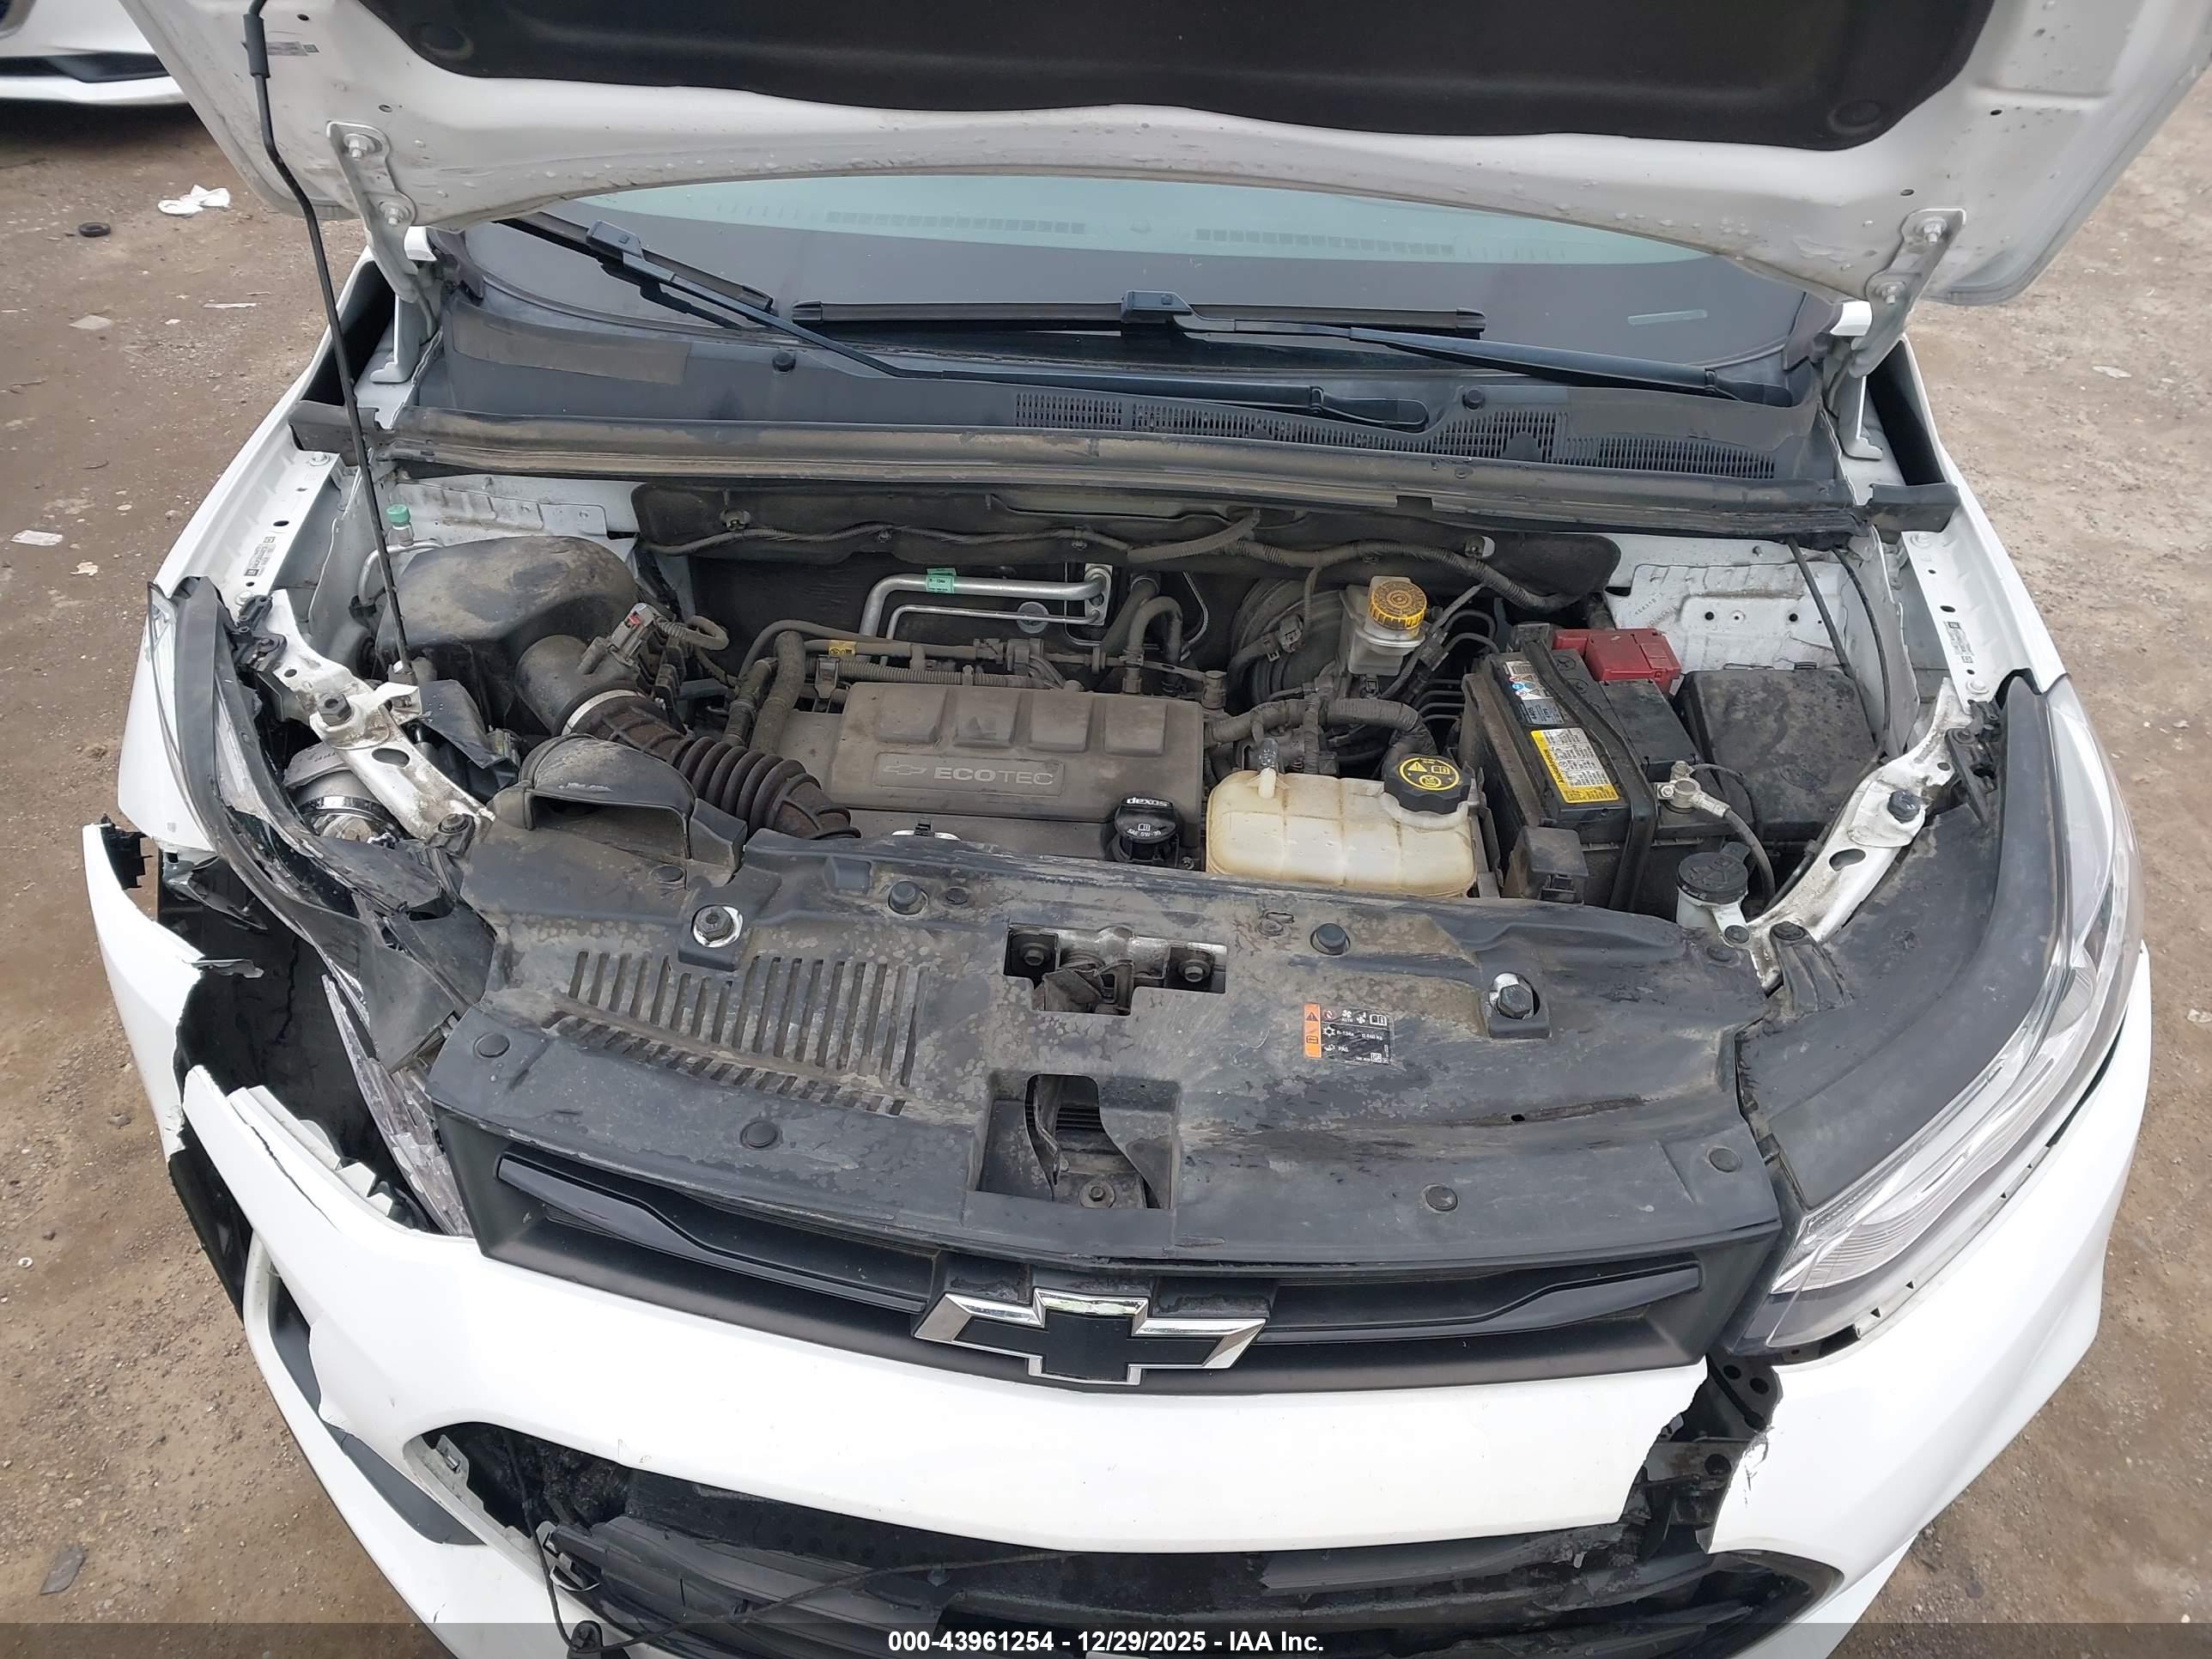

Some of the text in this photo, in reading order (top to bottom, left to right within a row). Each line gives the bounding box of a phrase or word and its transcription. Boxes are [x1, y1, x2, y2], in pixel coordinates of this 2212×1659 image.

[933, 767, 1054, 786] ECOTEC
[1126, 797, 1169, 807] dexos
[1127, 828, 1140, 836] SAE
